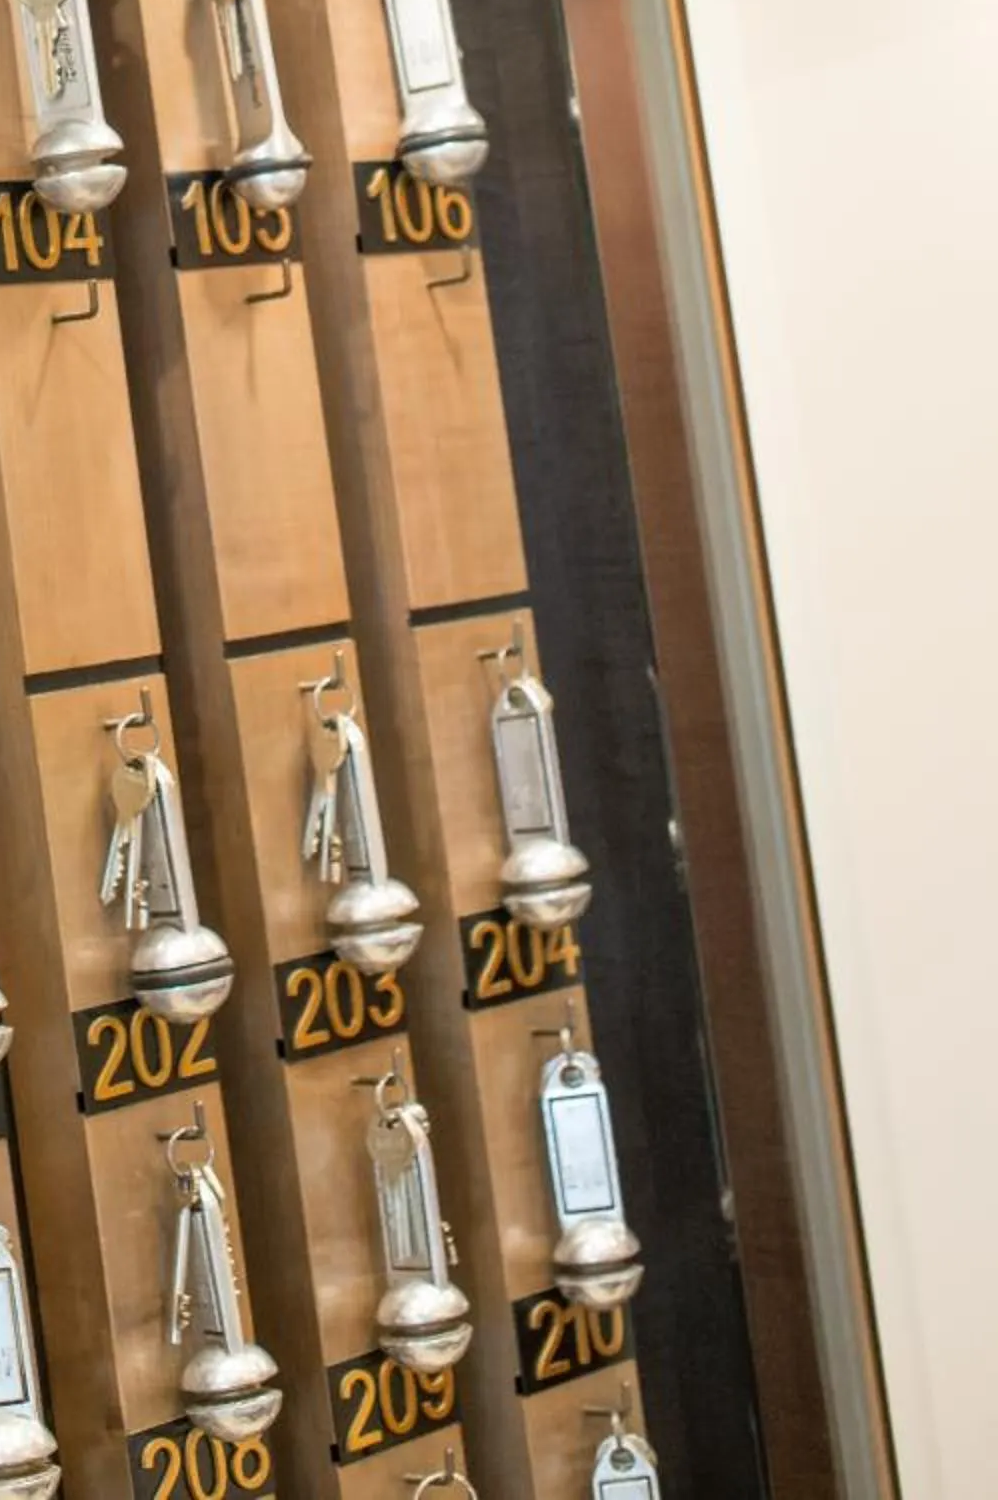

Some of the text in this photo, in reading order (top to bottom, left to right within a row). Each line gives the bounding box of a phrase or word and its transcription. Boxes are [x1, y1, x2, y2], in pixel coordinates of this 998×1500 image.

[366, 168, 473, 242] 106
[470, 920, 581, 998] 204
[286, 961, 406, 1049] 203
[87, 1007, 217, 1101] 202
[528, 1299, 624, 1379] 210
[339, 1357, 456, 1452] 209
